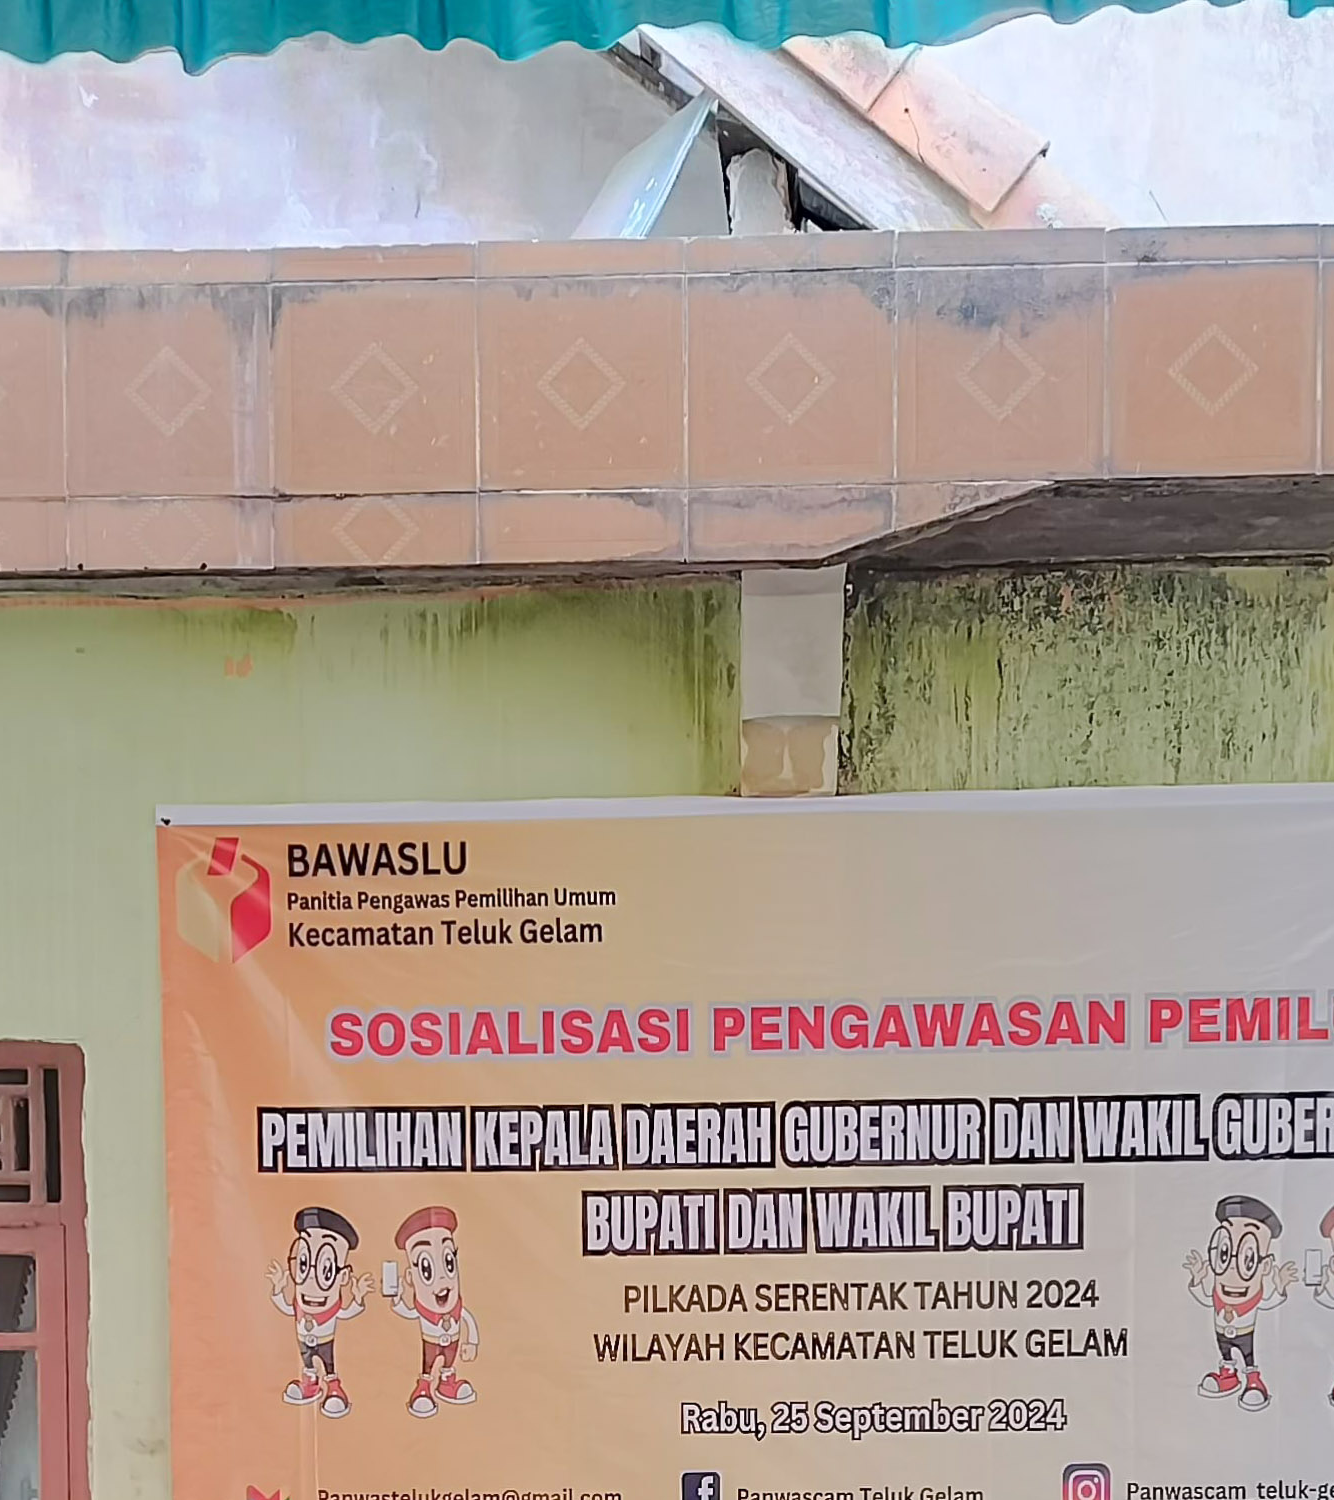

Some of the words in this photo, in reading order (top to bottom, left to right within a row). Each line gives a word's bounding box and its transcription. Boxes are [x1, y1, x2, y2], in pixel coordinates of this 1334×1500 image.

[287, 841, 468, 879] BAWASLU
[287, 892, 353, 911] Panitia
[357, 890, 450, 914] Pengawas
[455, 888, 549, 909] Pemilihan
[553, 888, 616, 907] Umum
[288, 921, 434, 948] Kecamatan
[441, 919, 512, 945] Teluk
[519, 918, 603, 945] Gelam
[329, 1008, 689, 1057] SOSIALISASI
[713, 1000, 1126, 1052] PENGAWASAN
[259, 1107, 466, 1171] PEMILIHAN
[471, 1105, 618, 1170] KEPALA
[623, 1101, 775, 1169] DAERAH
[782, 1098, 985, 1167] GUBERNUR
[989, 1096, 1074, 1163] DAN
[1079, 1094, 1209, 1161] WAKIL
[583, 1189, 720, 1255] BUPATI
[725, 1187, 807, 1253] DAN
[811, 1185, 938, 1252] WAKIL
[943, 1183, 1084, 1250] BUPATI
[624, 1284, 748, 1314] PILKADA
[755, 1282, 907, 1313] SERENTAK
[914, 1280, 1018, 1310] TAHUN
[1026, 1279, 1100, 1309] 2024
[594, 1332, 725, 1363] WILAYAH
[735, 1330, 916, 1361] KECAMATAN
[923, 1329, 1019, 1359] TELUK
[1025, 1327, 1129, 1358] GELAM
[680, 1402, 765, 1441] Rabu,
[770, 1402, 809, 1433] 25
[813, 1399, 984, 1440] September
[989, 1399, 1067, 1432] 2024
